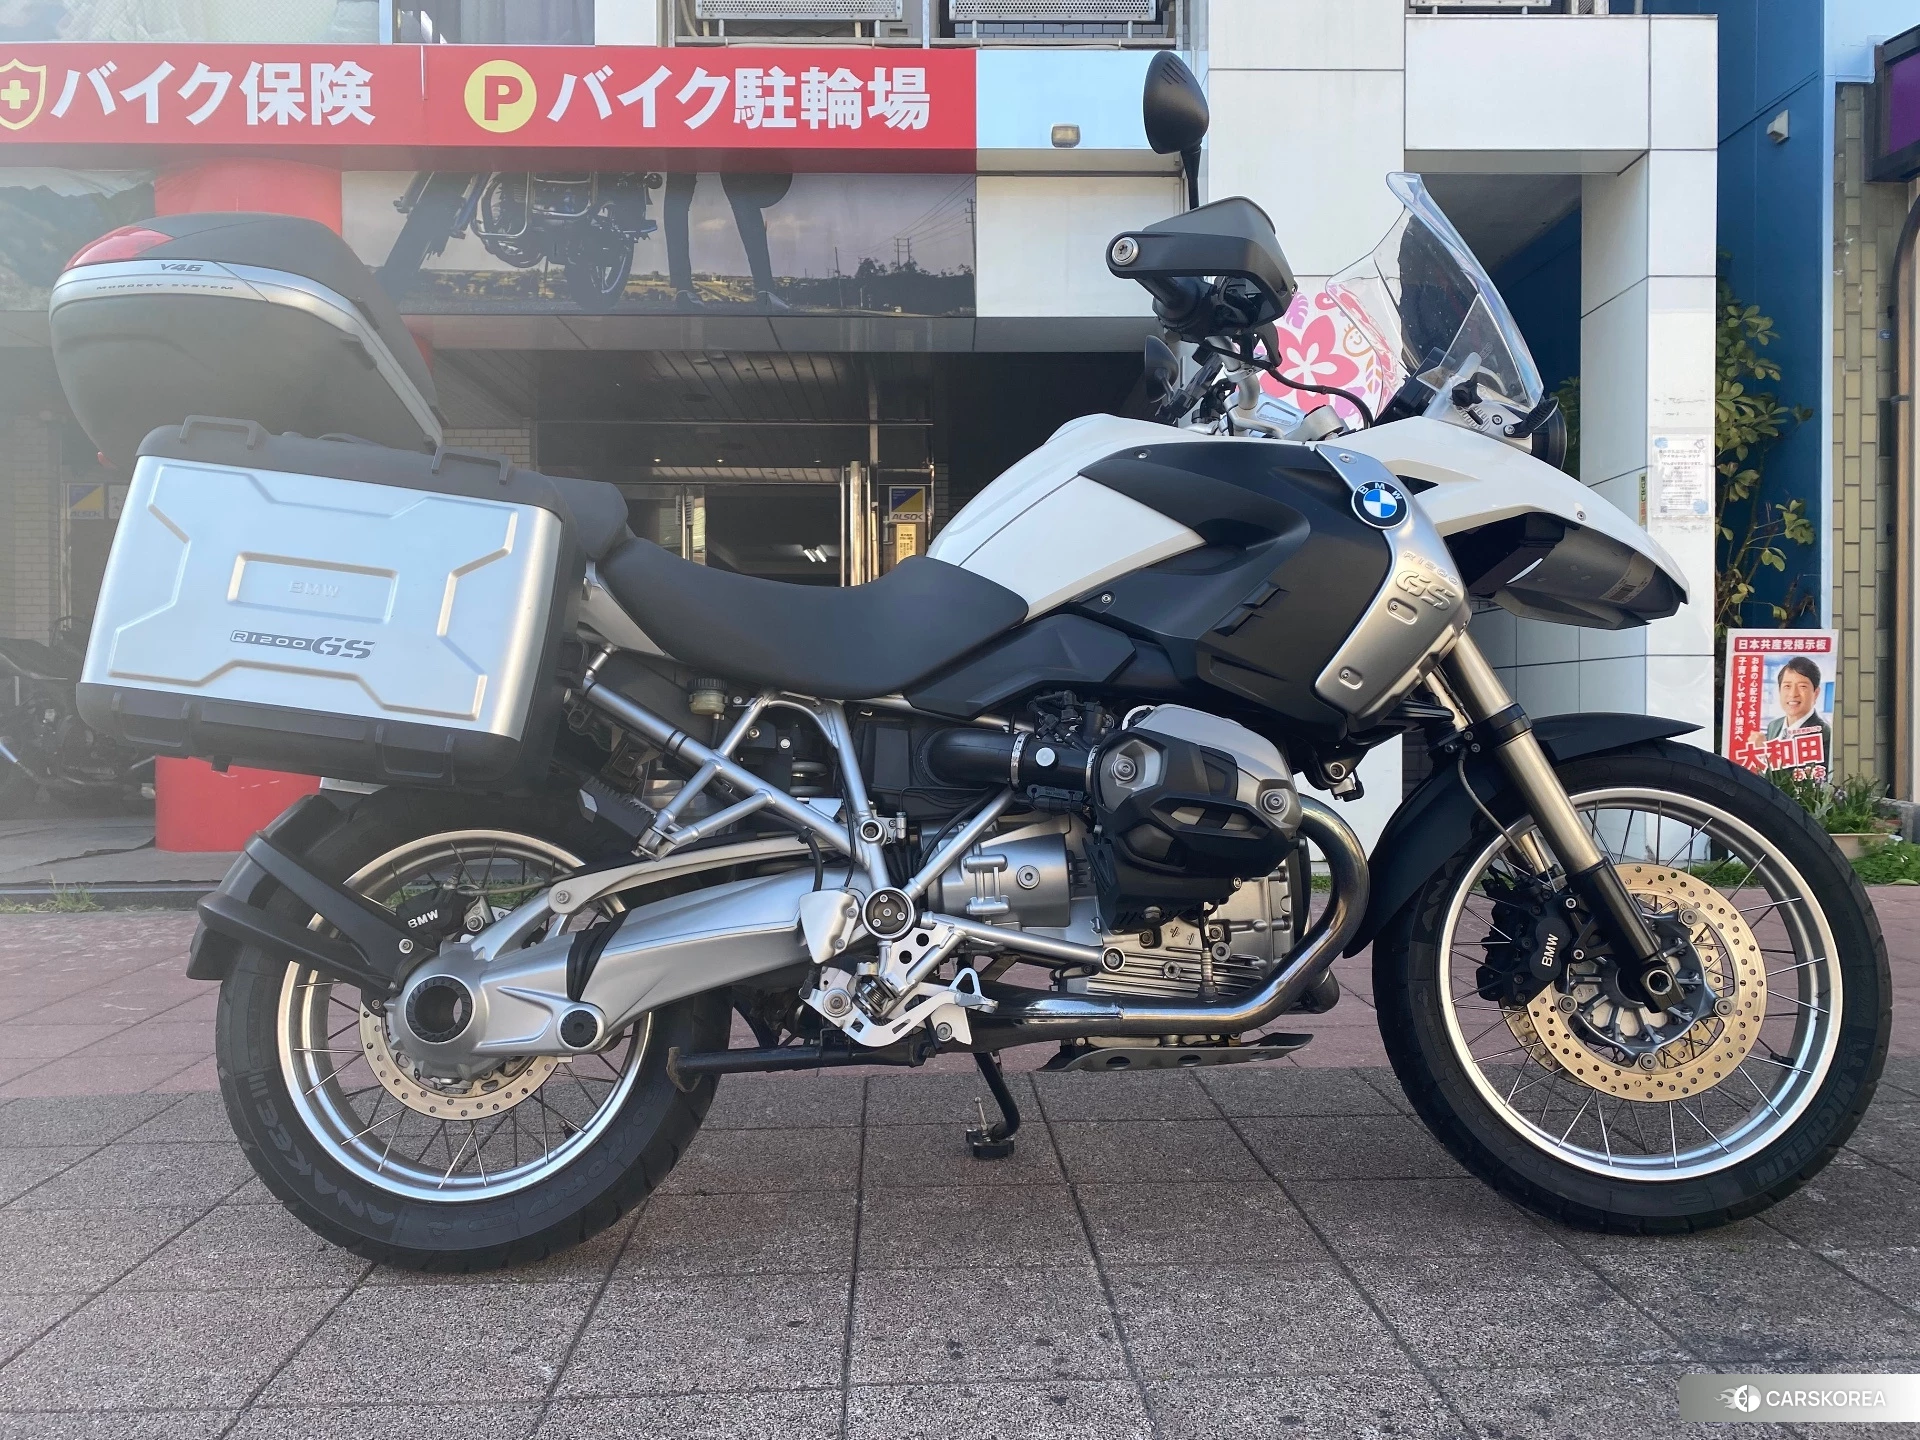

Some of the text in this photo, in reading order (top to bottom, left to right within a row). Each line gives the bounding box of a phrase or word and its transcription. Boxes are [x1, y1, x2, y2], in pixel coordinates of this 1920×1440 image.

[51, 60, 376, 126] バイク保険
[484, 75, 522, 121] P
[547, 65, 930, 130] バイク駐輪場
[161, 263, 204, 272] V46
[1358, 482, 1403, 501] BMW
[892, 513, 924, 521] ALSOK
[288, 580, 340, 598] BMW
[1395, 570, 1457, 611] GS
[1738, 638, 1827, 651] 日本共産党掲示板
[1734, 656, 1748, 742] 子育てしやすい横浜へ
[407, 909, 439, 929] BMW
[1541, 933, 1559, 967] BMW
[1755, 1071, 1858, 1188] MICHELIN
